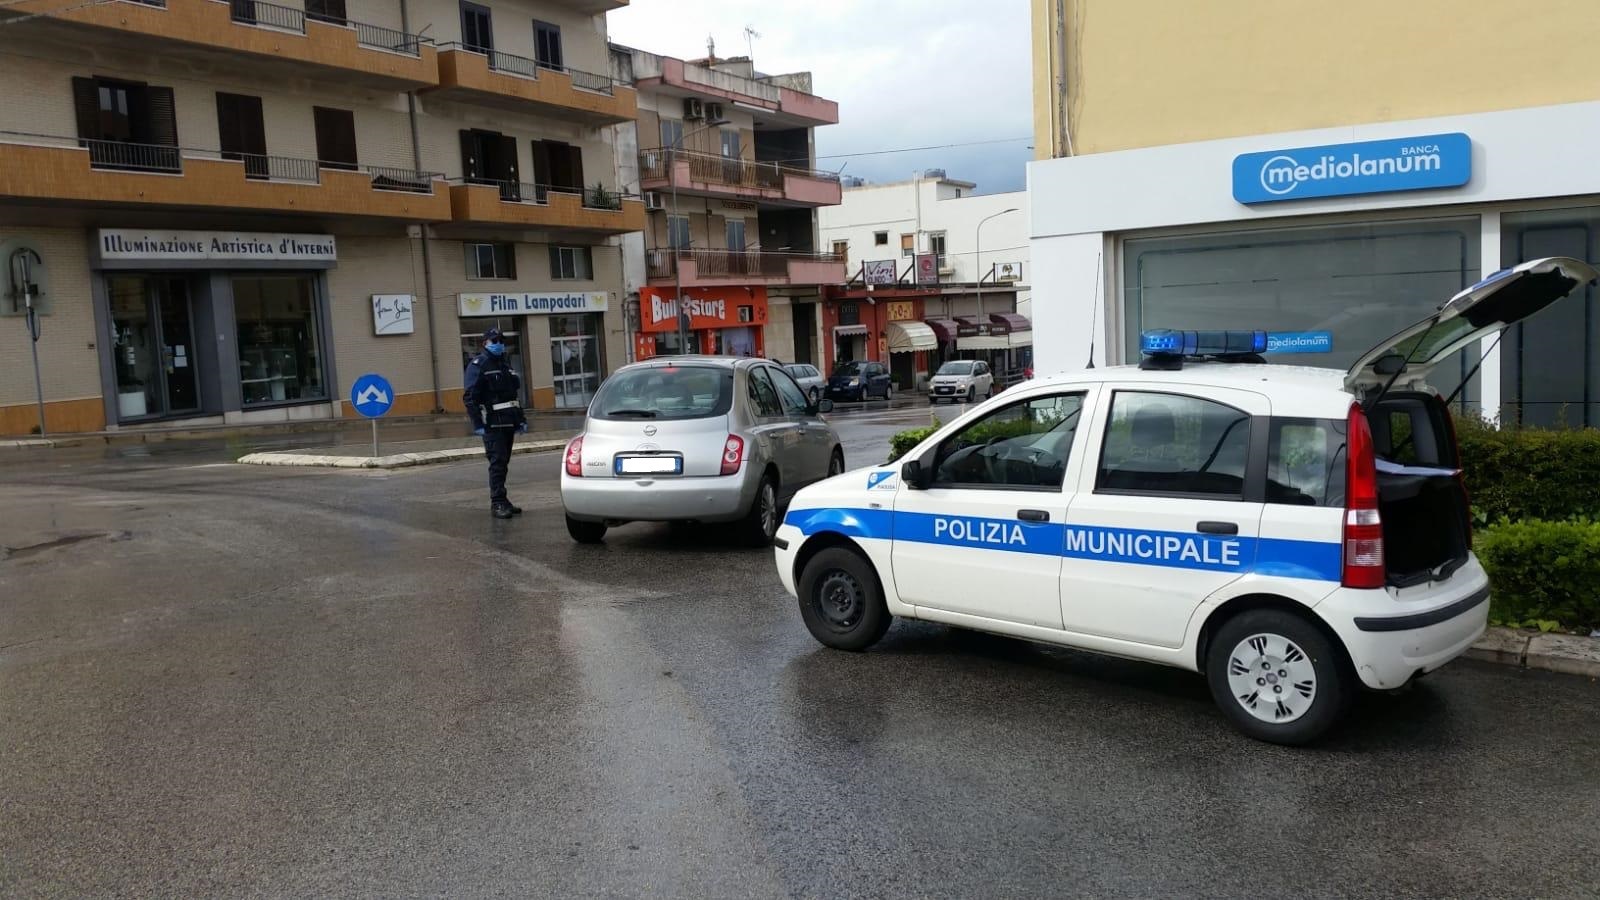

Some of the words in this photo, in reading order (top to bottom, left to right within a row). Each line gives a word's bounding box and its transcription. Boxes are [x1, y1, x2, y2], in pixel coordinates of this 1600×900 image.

[1401, 144, 1440, 156] BANCA
[1268, 153, 1440, 185] mediolanum
[490, 295, 518, 312] Film
[525, 293, 586, 313] Lampadari
[1267, 336, 1329, 347] mediolanum
[934, 518, 1027, 547] POLIZIA
[1066, 528, 1240, 566] MUNICIPALE
